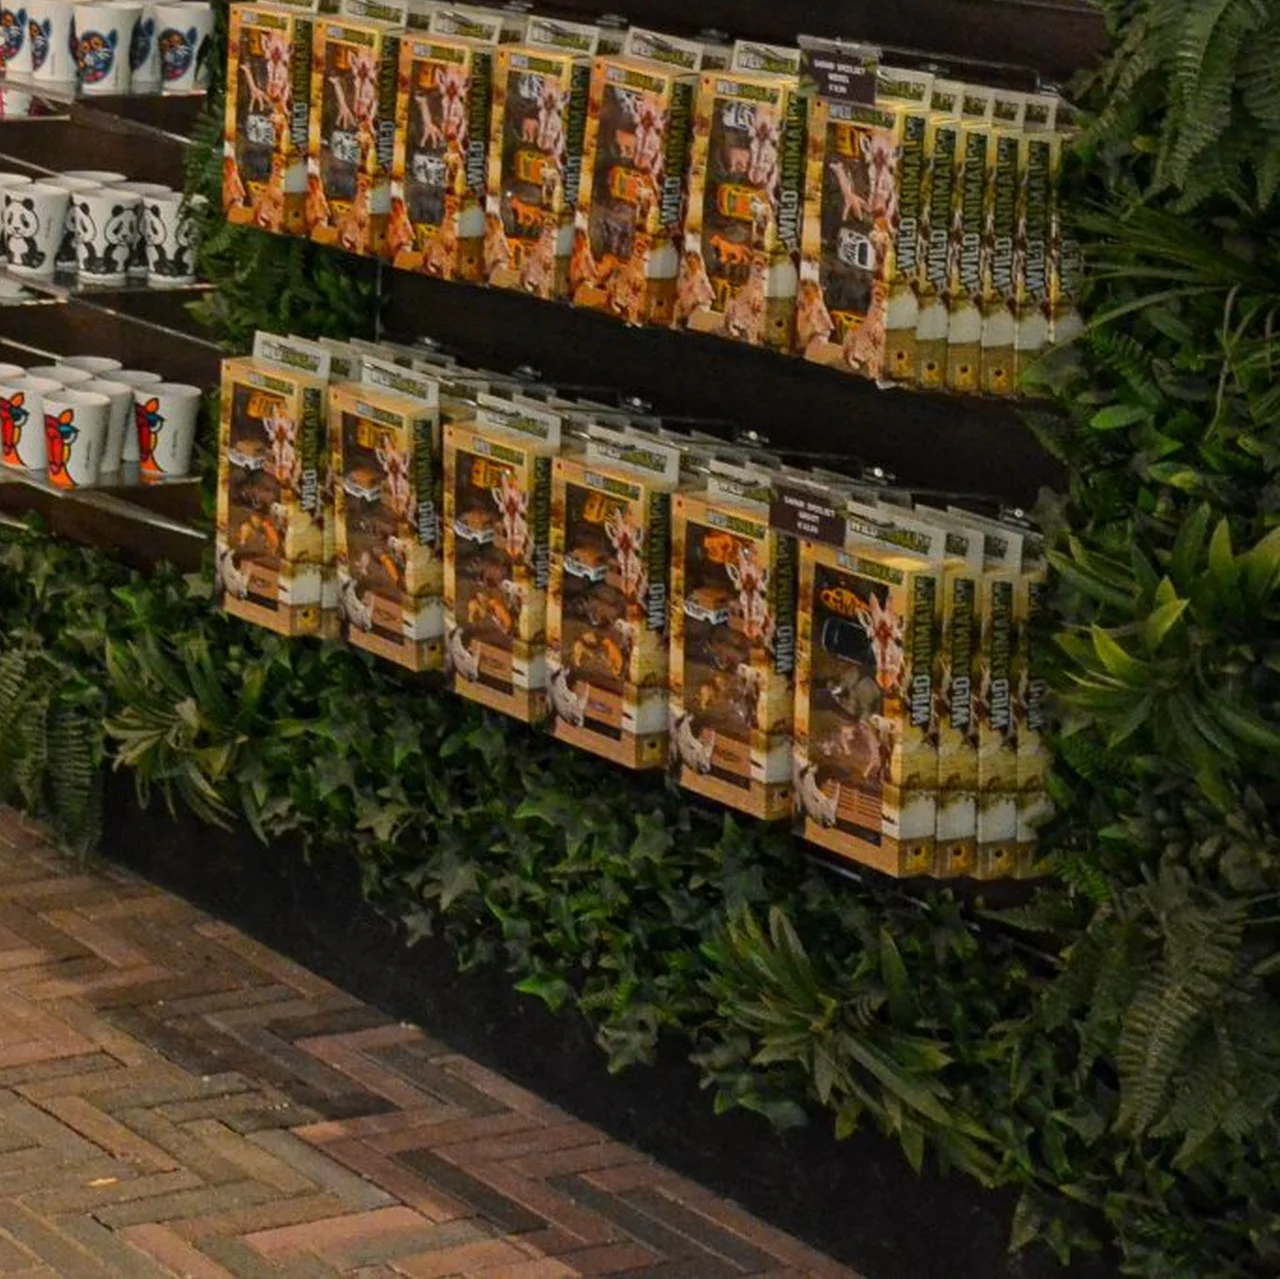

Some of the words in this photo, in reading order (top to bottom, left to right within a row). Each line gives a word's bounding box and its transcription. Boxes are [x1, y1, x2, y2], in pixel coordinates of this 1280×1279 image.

[662, 176, 680, 224] WILD
[778, 190, 798, 241] WILD
[897, 218, 917, 270] WILD
[929, 229, 947, 283] WILD
[961, 233, 980, 289] WILD
[993, 236, 1011, 291] WILD
[648, 582, 666, 630] WILD
[776, 625, 794, 673] WILD
[912, 675, 931, 727] WILD
[951, 675, 970, 729] WILD
[990, 678, 1009, 731] WILD
